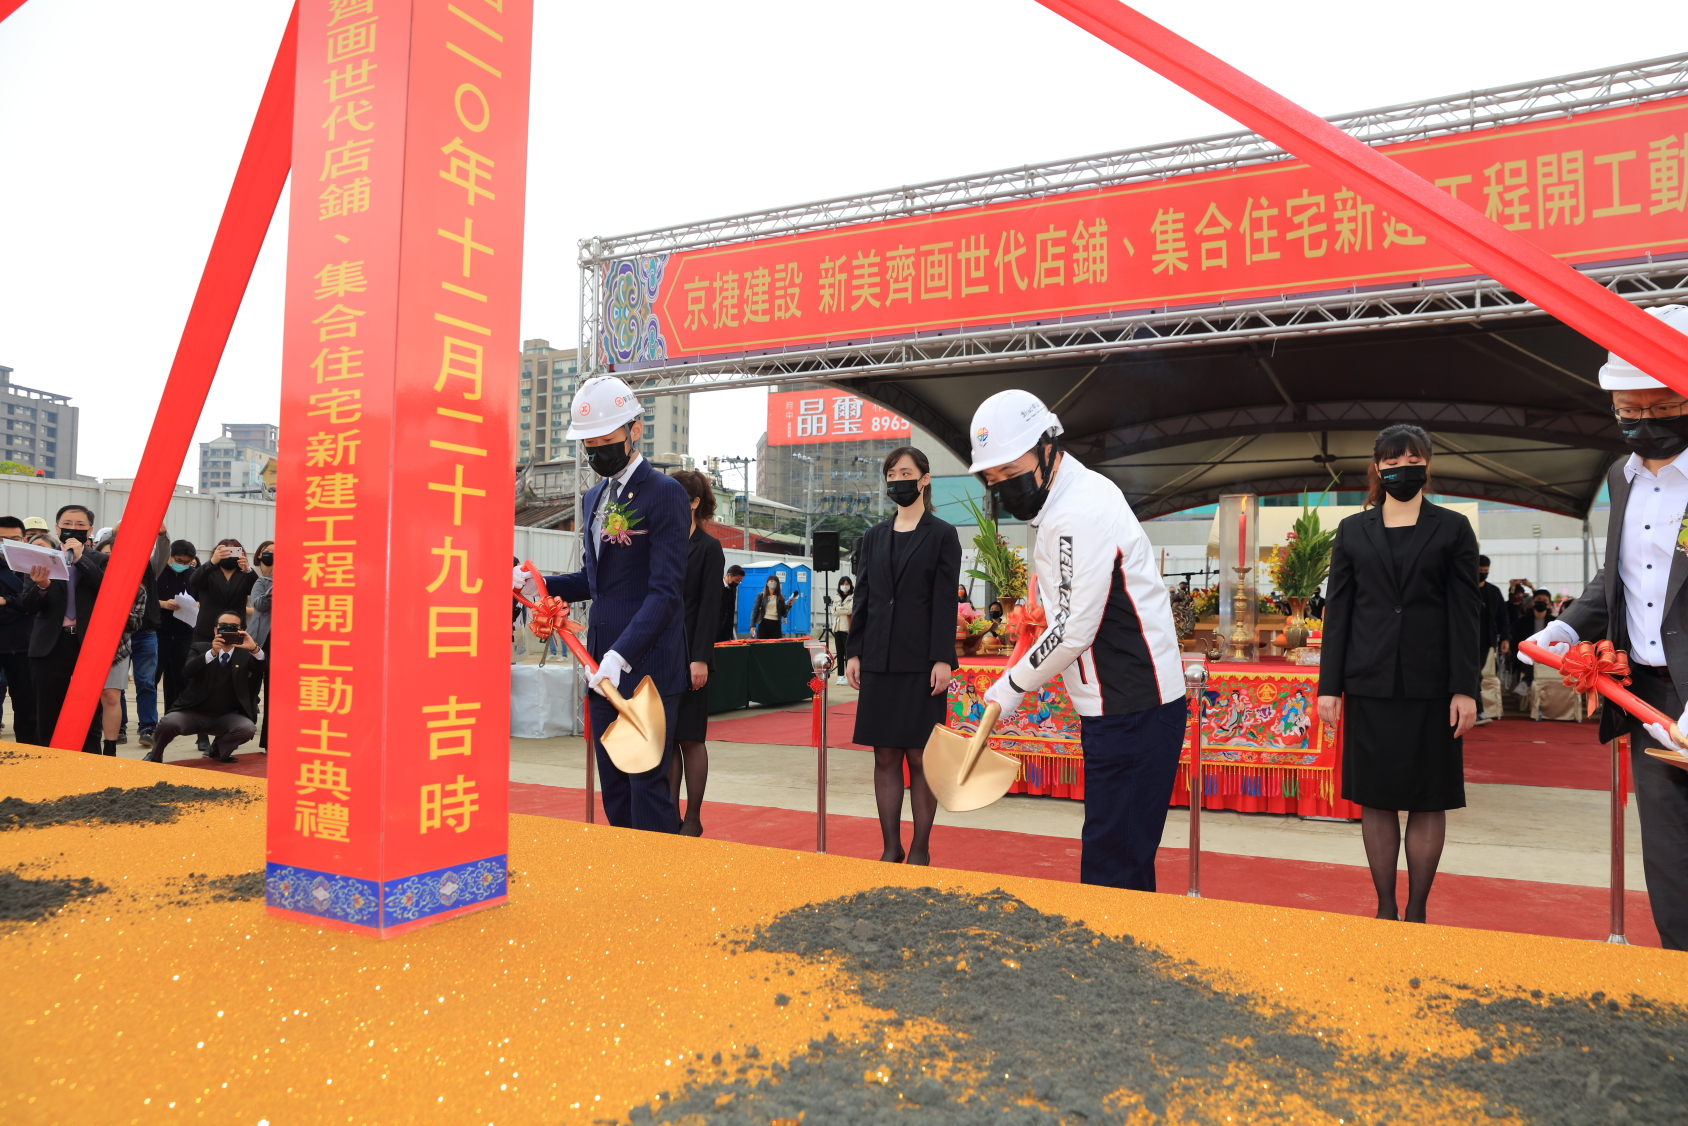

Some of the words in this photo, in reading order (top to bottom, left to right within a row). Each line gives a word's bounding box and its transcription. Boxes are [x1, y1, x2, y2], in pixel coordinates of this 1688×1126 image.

[683, 262, 804, 331] 京捷建設
[818, 131, 1688, 314] 新美齊画世代店鋪、集合住宅新程開工動
[797, 396, 864, 437] 晶璽
[871, 415, 910, 432] 8965
[1060, 536, 1073, 579] NEW
[1036, 633, 1060, 665] CITY
[1258, 682, 1277, 700] 金
[420, 695, 482, 835] 吉時
